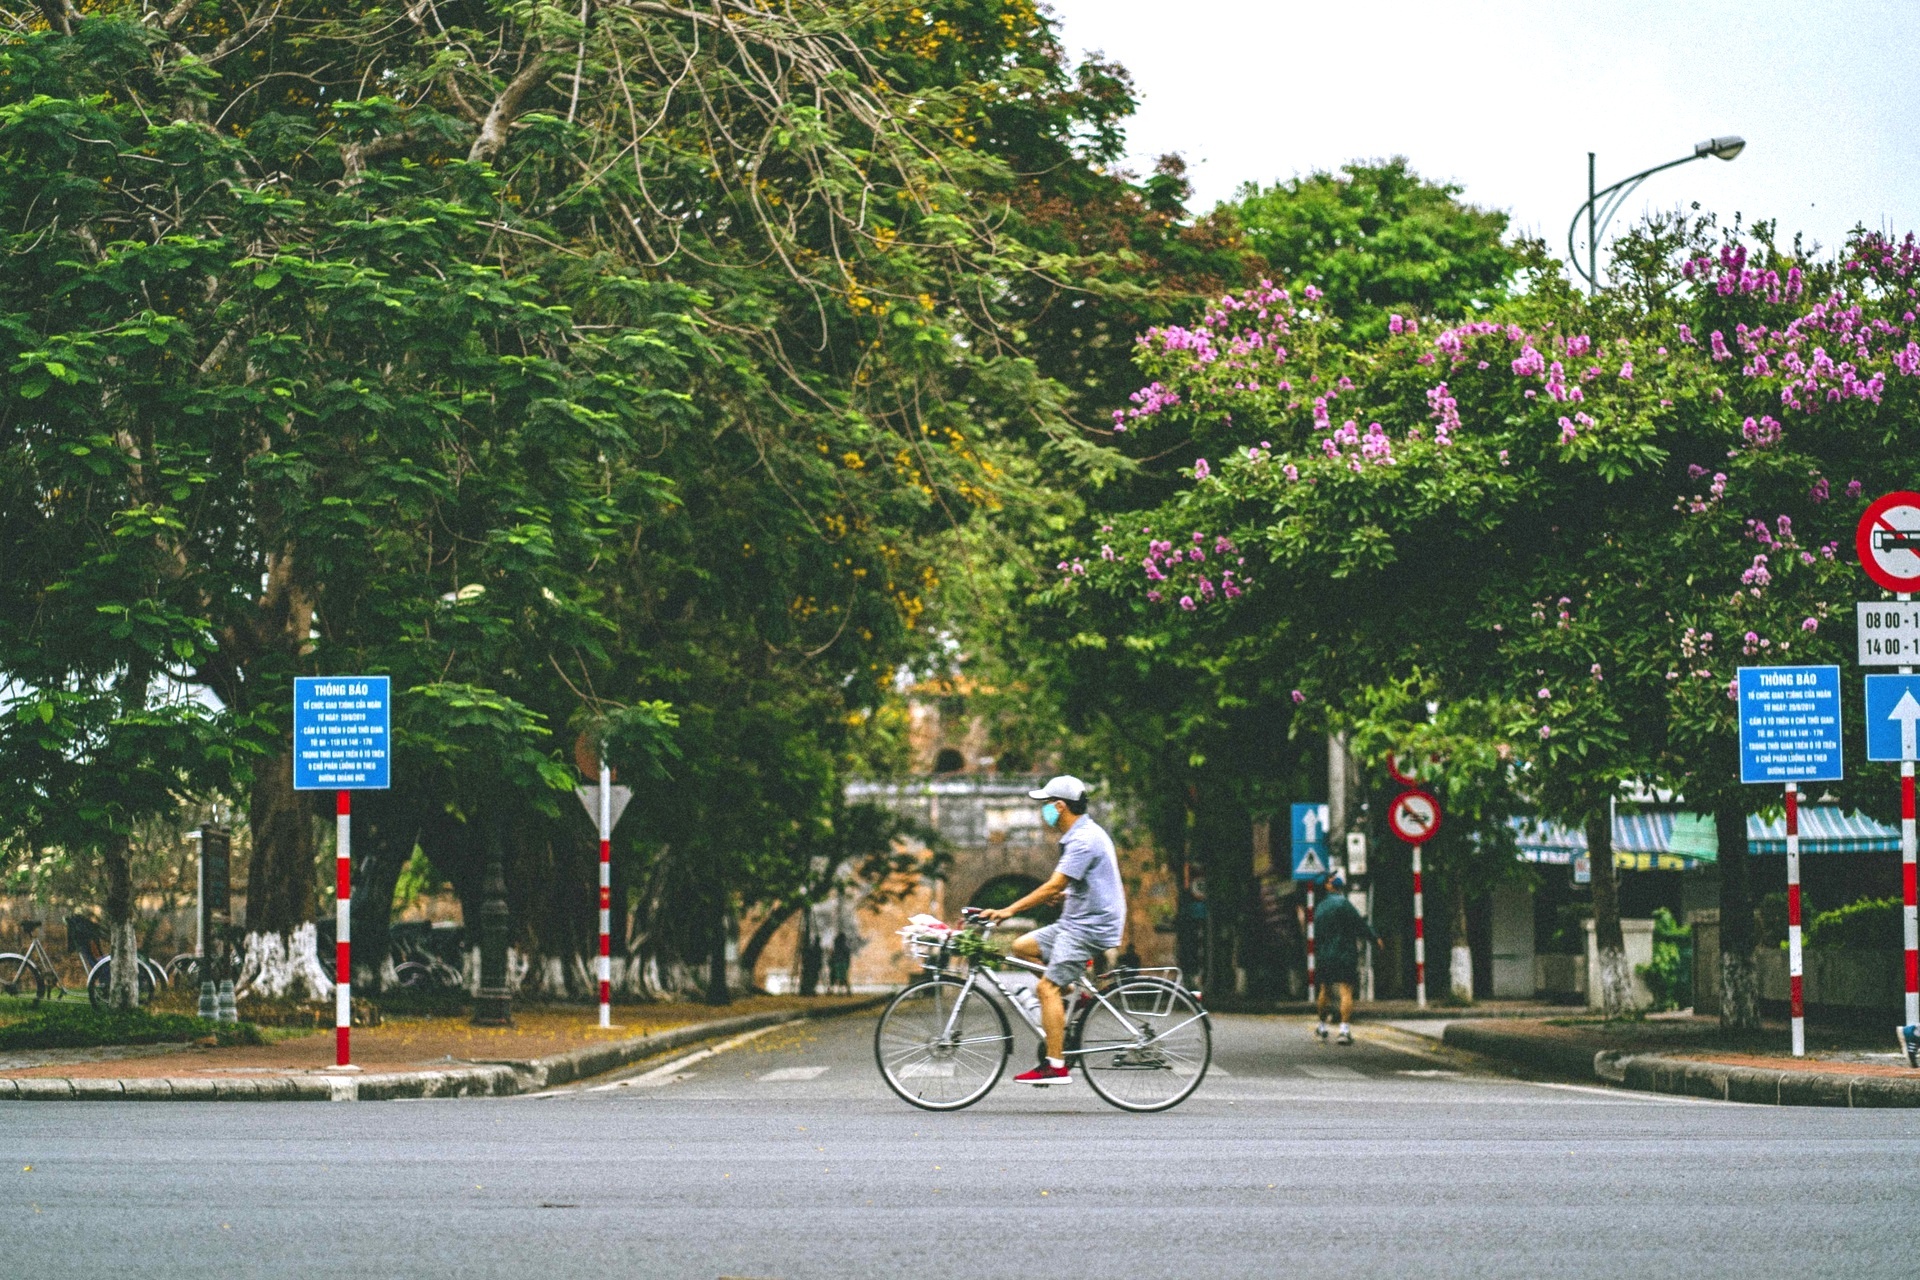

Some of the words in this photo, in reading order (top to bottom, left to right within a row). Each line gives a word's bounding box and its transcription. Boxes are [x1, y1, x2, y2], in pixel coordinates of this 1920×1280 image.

[1866, 612, 1881, 628] 08
[1885, 612, 1900, 628] 00
[1866, 639, 1881, 654] 14
[1885, 639, 1900, 654] 00
[1760, 672, 1793, 686] THÔNG
[1796, 671, 1817, 685] BÁO
[314, 682, 346, 696] THÔNG
[348, 682, 368, 695] BÁO
